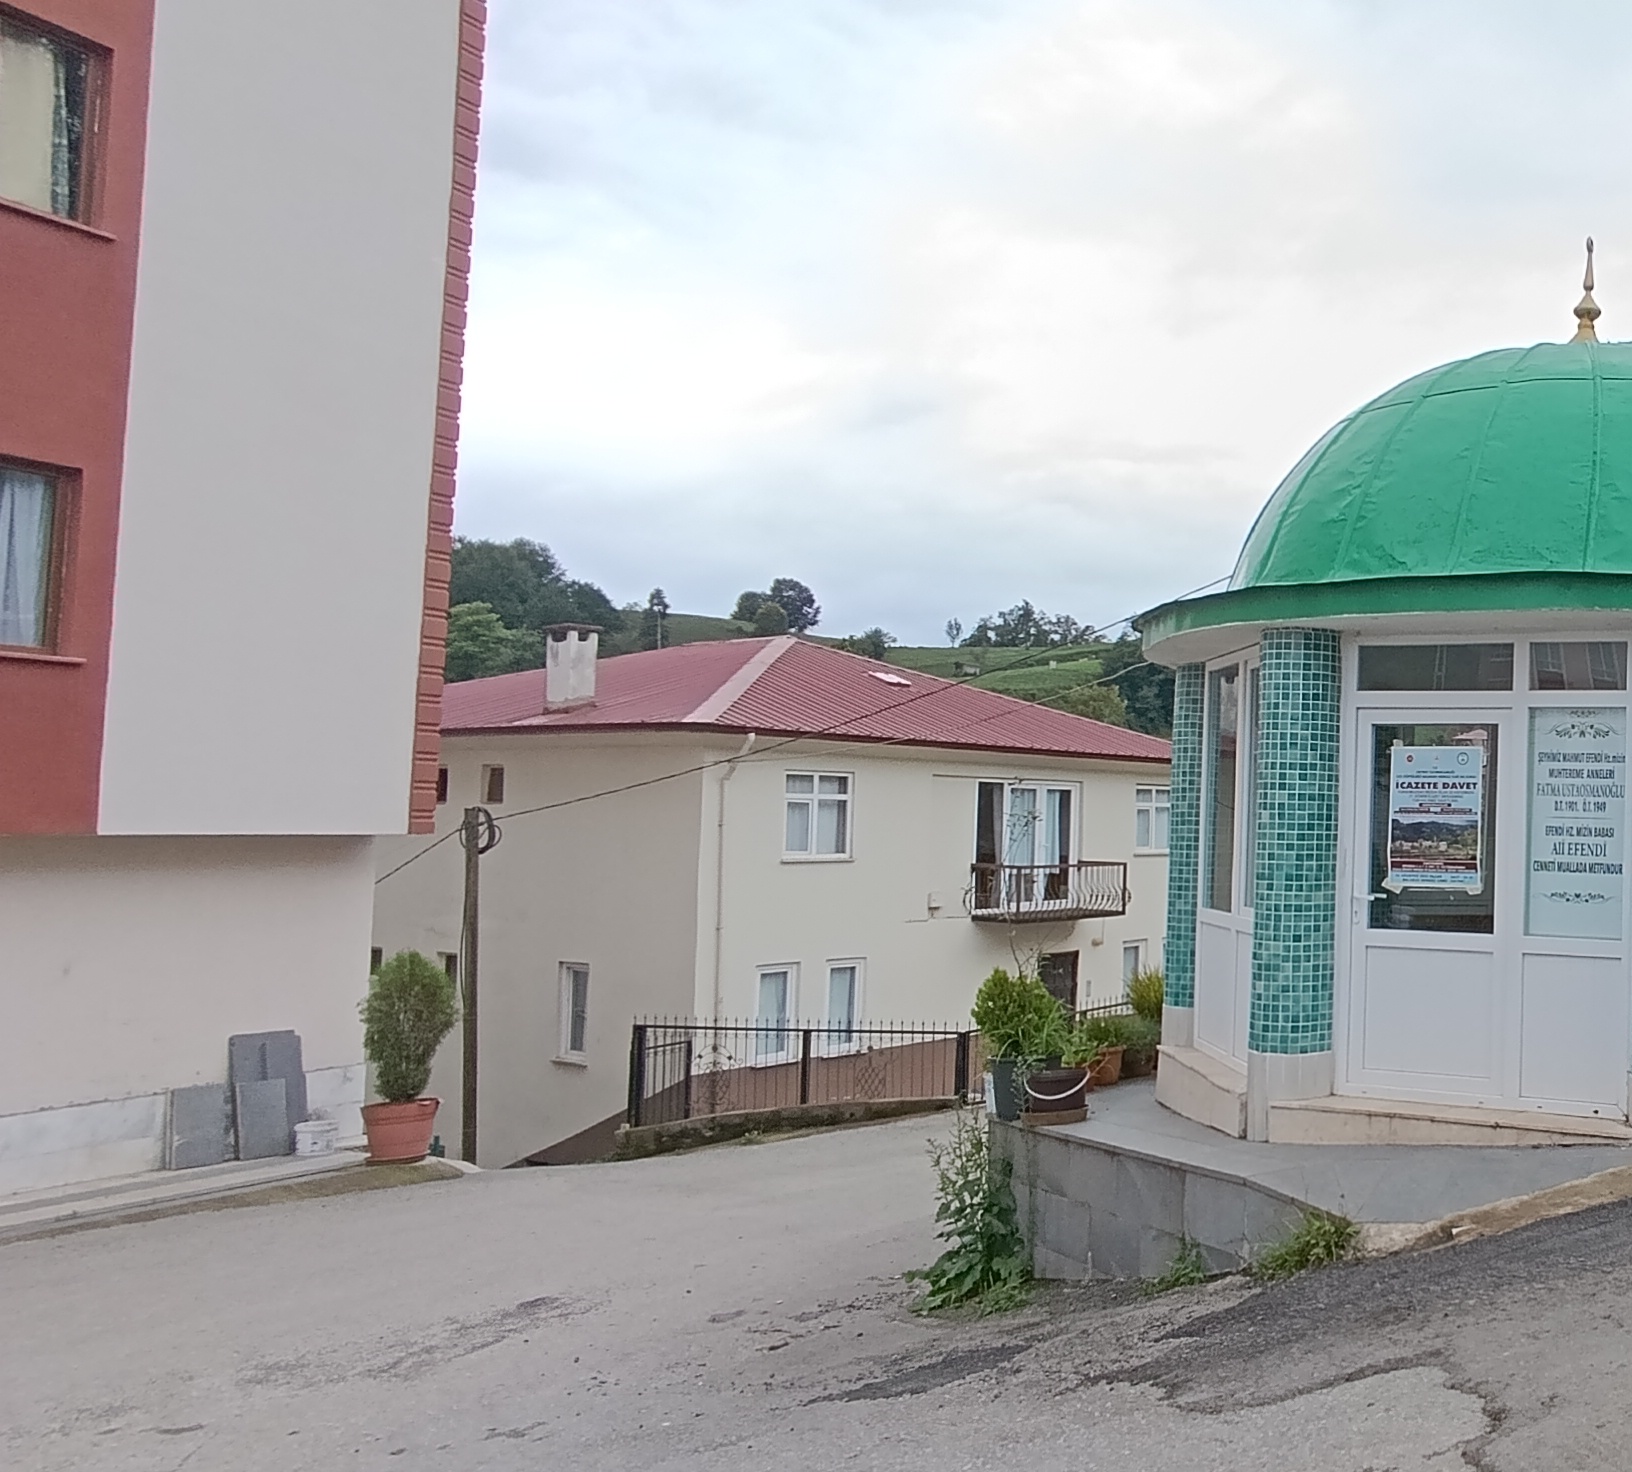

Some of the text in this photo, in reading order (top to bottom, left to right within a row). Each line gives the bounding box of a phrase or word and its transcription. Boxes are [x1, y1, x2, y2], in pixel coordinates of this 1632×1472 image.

[1562, 752, 1584, 763] MAHMUT
[1586, 749, 1603, 763] EFENDİ
[1548, 766, 1615, 779] MUHTEREME ANNELERİ
[1396, 780, 1478, 790] İCAZETE DAVET
[1536, 781, 1626, 798] FATMA USTAOSMANOĞLU
[1545, 823, 1565, 836] EFENDİ
[1576, 824, 1593, 837] MİZİN
[1593, 826, 1615, 838] BABASI
[1567, 840, 1607, 857] EFENDİ
[1533, 858, 1556, 872] CENNETİ
